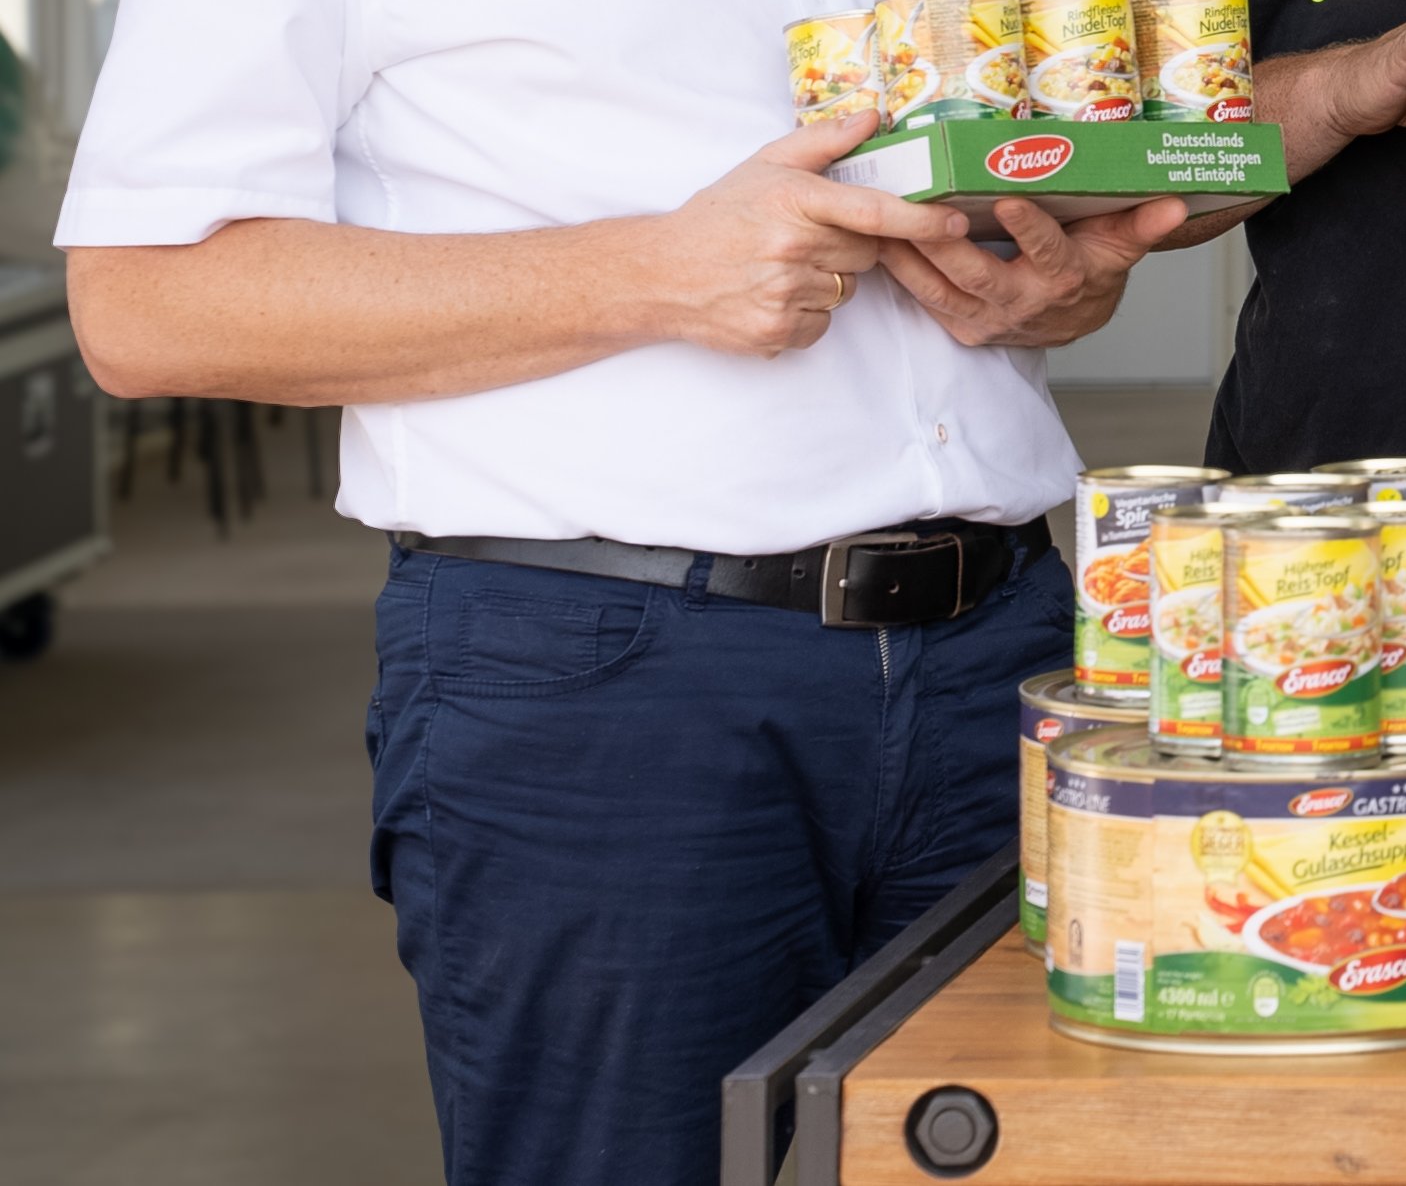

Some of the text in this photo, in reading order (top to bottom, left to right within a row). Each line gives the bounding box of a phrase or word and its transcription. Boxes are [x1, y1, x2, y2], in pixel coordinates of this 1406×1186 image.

[1067, 3, 1122, 21] Rindfleisch
[1200, 17, 1248, 33] Nudel-Top
[1081, 102, 1132, 122] Erasco
[1162, 133, 1244, 148] Deutschlands
[998, 143, 1065, 177] Erasco
[1147, 150, 1261, 168] beliebteste Suppen
[1168, 167, 1245, 185] und Eintöpfe
[1114, 492, 1177, 508] Vegetarische
[1284, 558, 1335, 575] Hühner
[1108, 608, 1149, 632] Eras
[1187, 653, 1222, 678] Era
[1282, 665, 1351, 692] Erasco
[1296, 793, 1346, 815] Erasco
[1329, 823, 1395, 852] Kessel-
